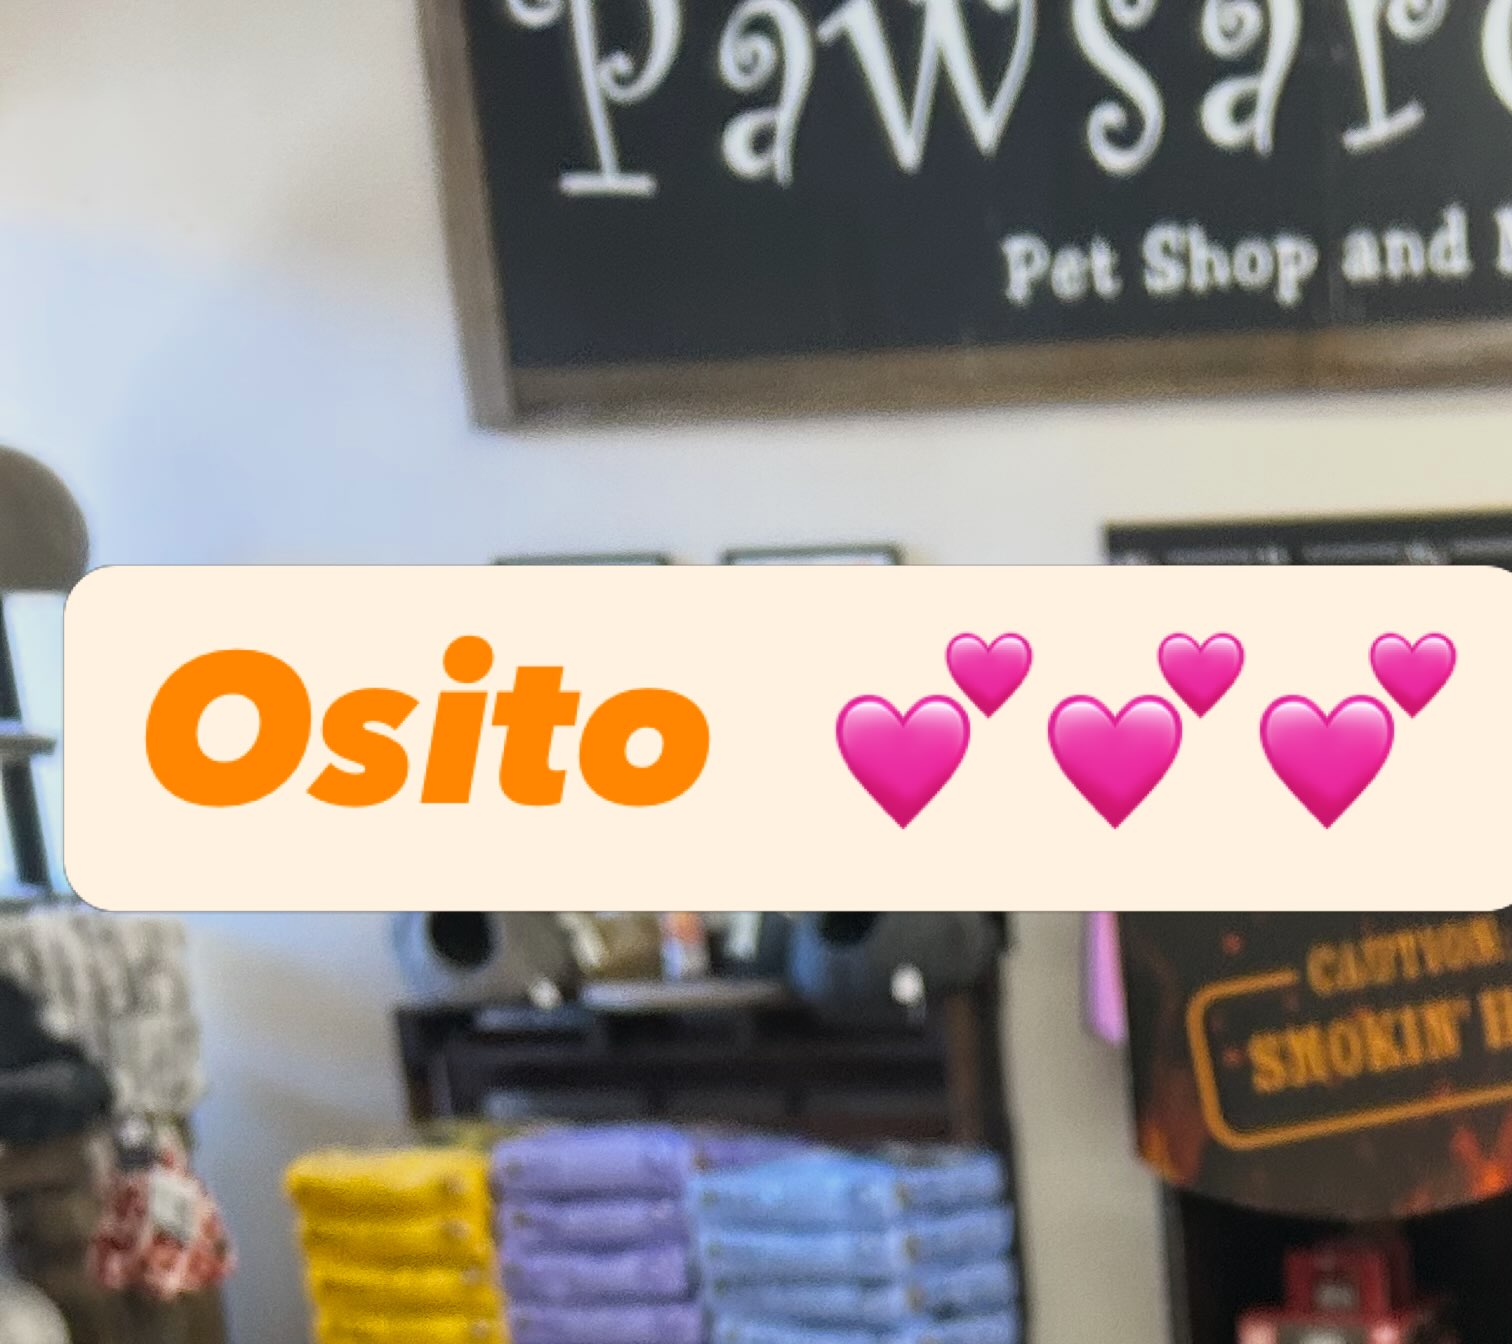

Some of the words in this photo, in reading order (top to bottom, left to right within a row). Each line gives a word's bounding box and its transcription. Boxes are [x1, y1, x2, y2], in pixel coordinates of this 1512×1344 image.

[1002, 234, 1120, 304] Pet
[1141, 222, 1318, 306] Shop
[1341, 202, 1473, 282] and
